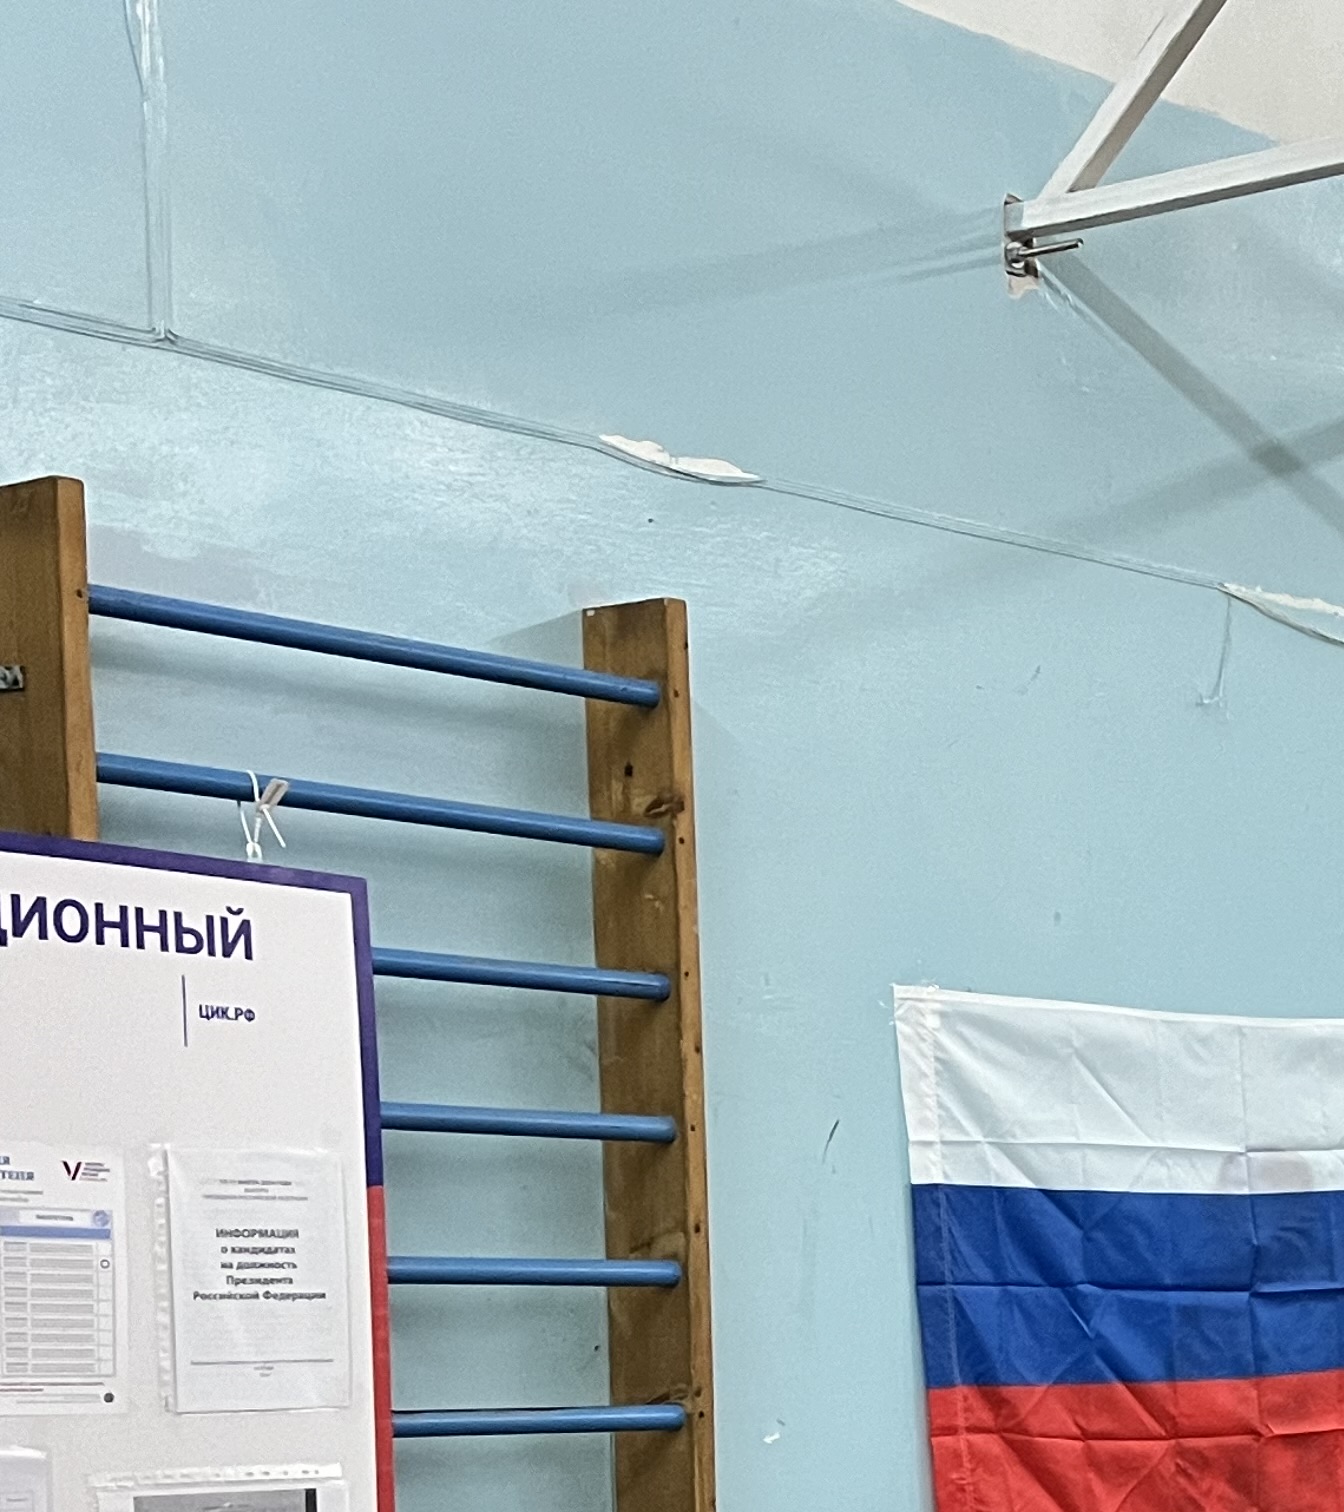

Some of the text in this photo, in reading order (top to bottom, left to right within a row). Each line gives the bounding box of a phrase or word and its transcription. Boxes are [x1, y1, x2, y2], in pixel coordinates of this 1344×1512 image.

[199, 1003, 256, 1023] ЦИК.РФ
[215, 1228, 299, 1239] ИНФОРМАЦИЯ
[231, 1246, 296, 1255] кандидатах
[226, 1275, 293, 1286] Президента
[193, 1290, 327, 1302] Российской Федерации
